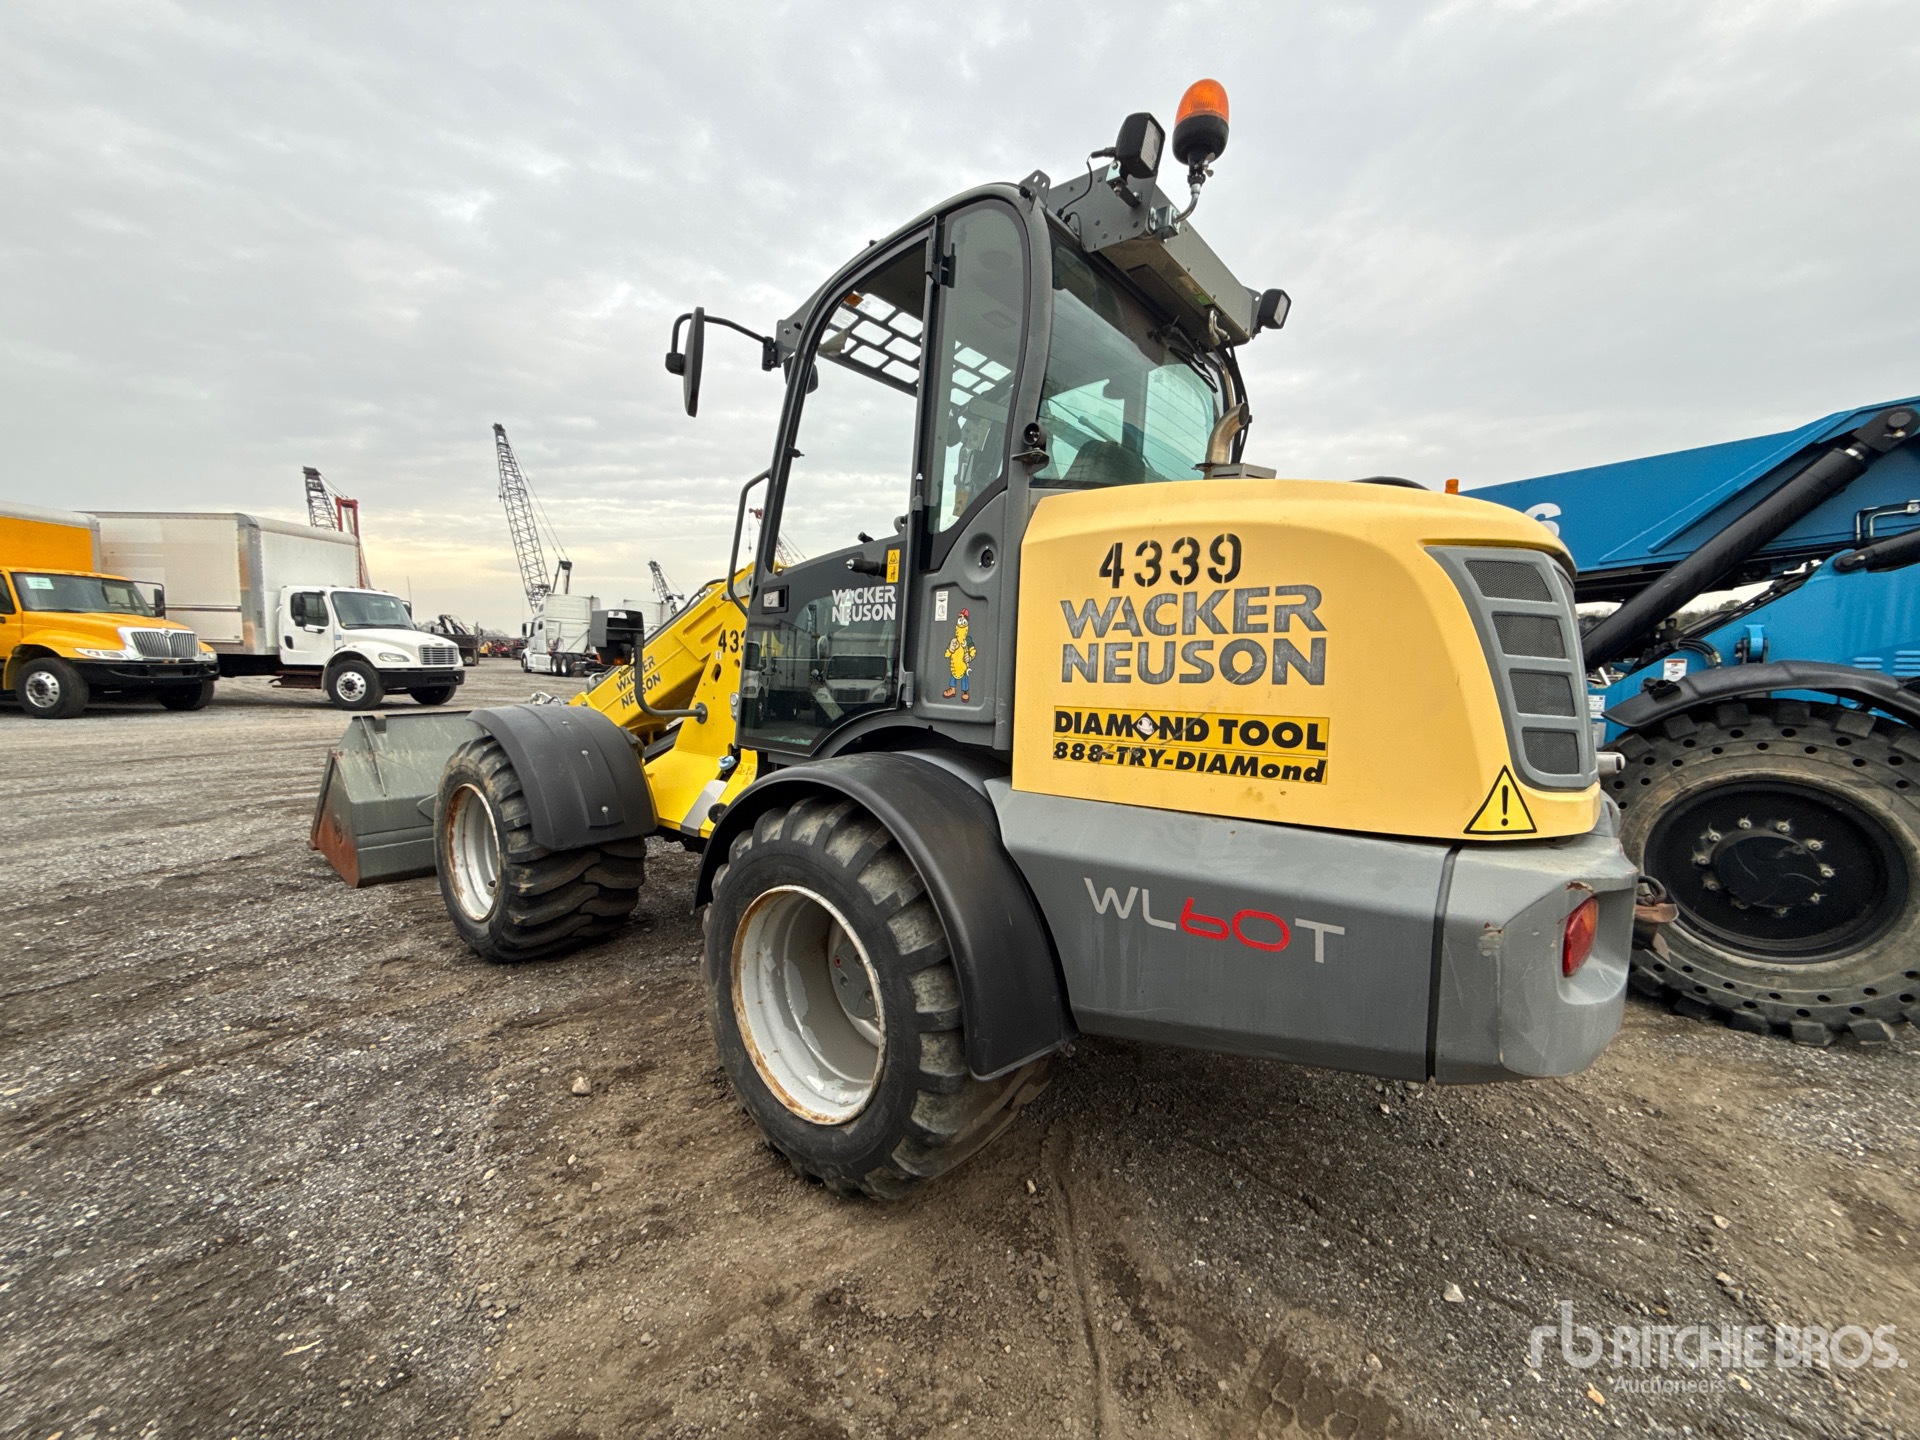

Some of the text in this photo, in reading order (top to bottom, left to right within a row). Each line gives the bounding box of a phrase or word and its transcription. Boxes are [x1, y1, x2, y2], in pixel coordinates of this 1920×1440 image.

[1099, 533, 1242, 589] 4339
[832, 585, 896, 605] WACKER
[832, 603, 896, 622] NEUSON
[1060, 584, 1328, 638] WACKER
[616, 656, 656, 692] WACER
[1061, 637, 1327, 686] NEUSON
[621, 672, 661, 709] NESON
[1218, 719, 1326, 751] TOOL
